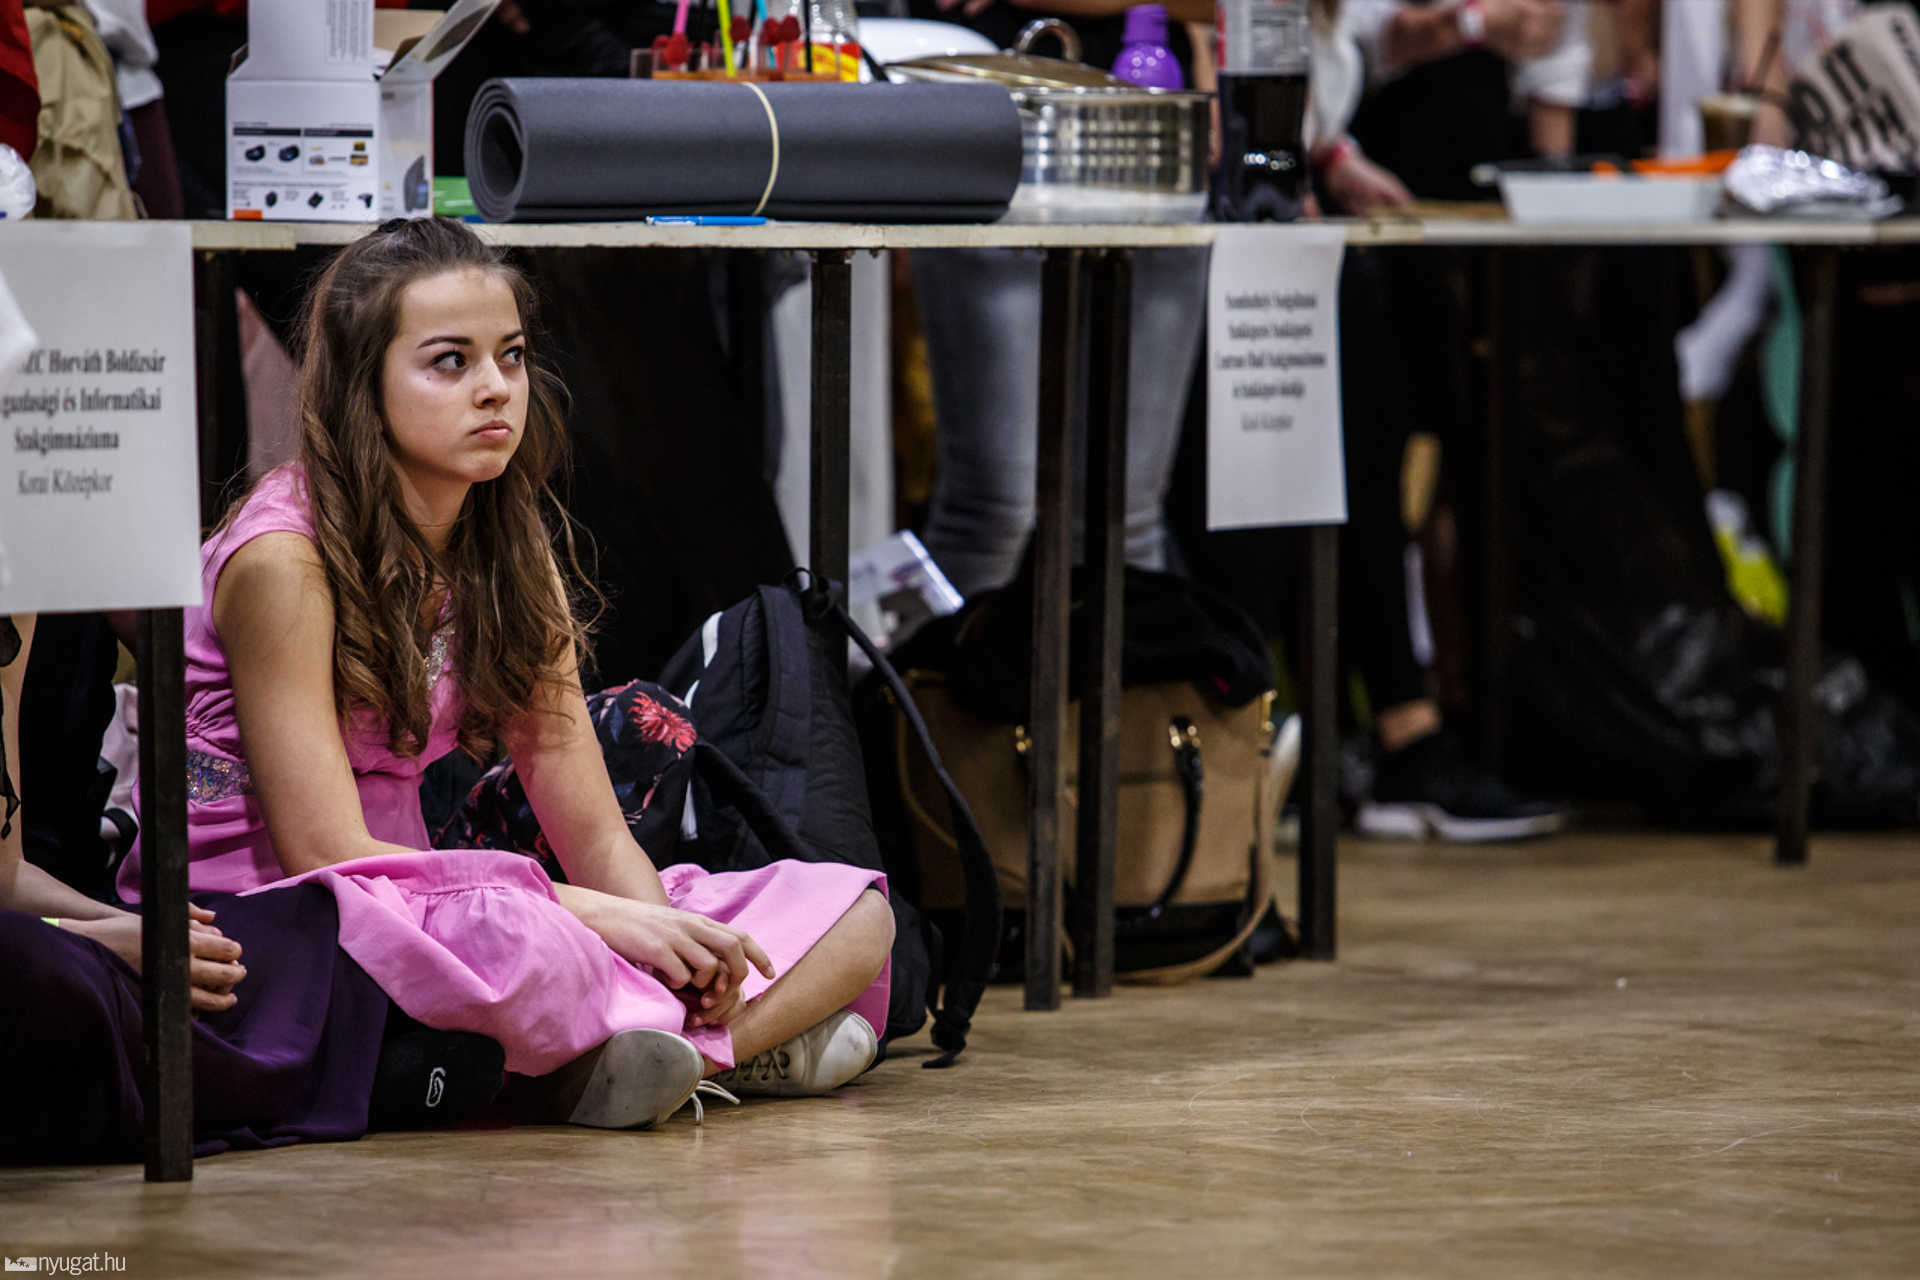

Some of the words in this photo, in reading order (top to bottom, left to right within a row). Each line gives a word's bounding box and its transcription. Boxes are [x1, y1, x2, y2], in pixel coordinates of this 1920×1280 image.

[48, 348, 101, 374] Horváth
[106, 347, 165, 374] Boldizsár
[63, 387, 76, 412] és
[80, 386, 161, 412] Informatikai
